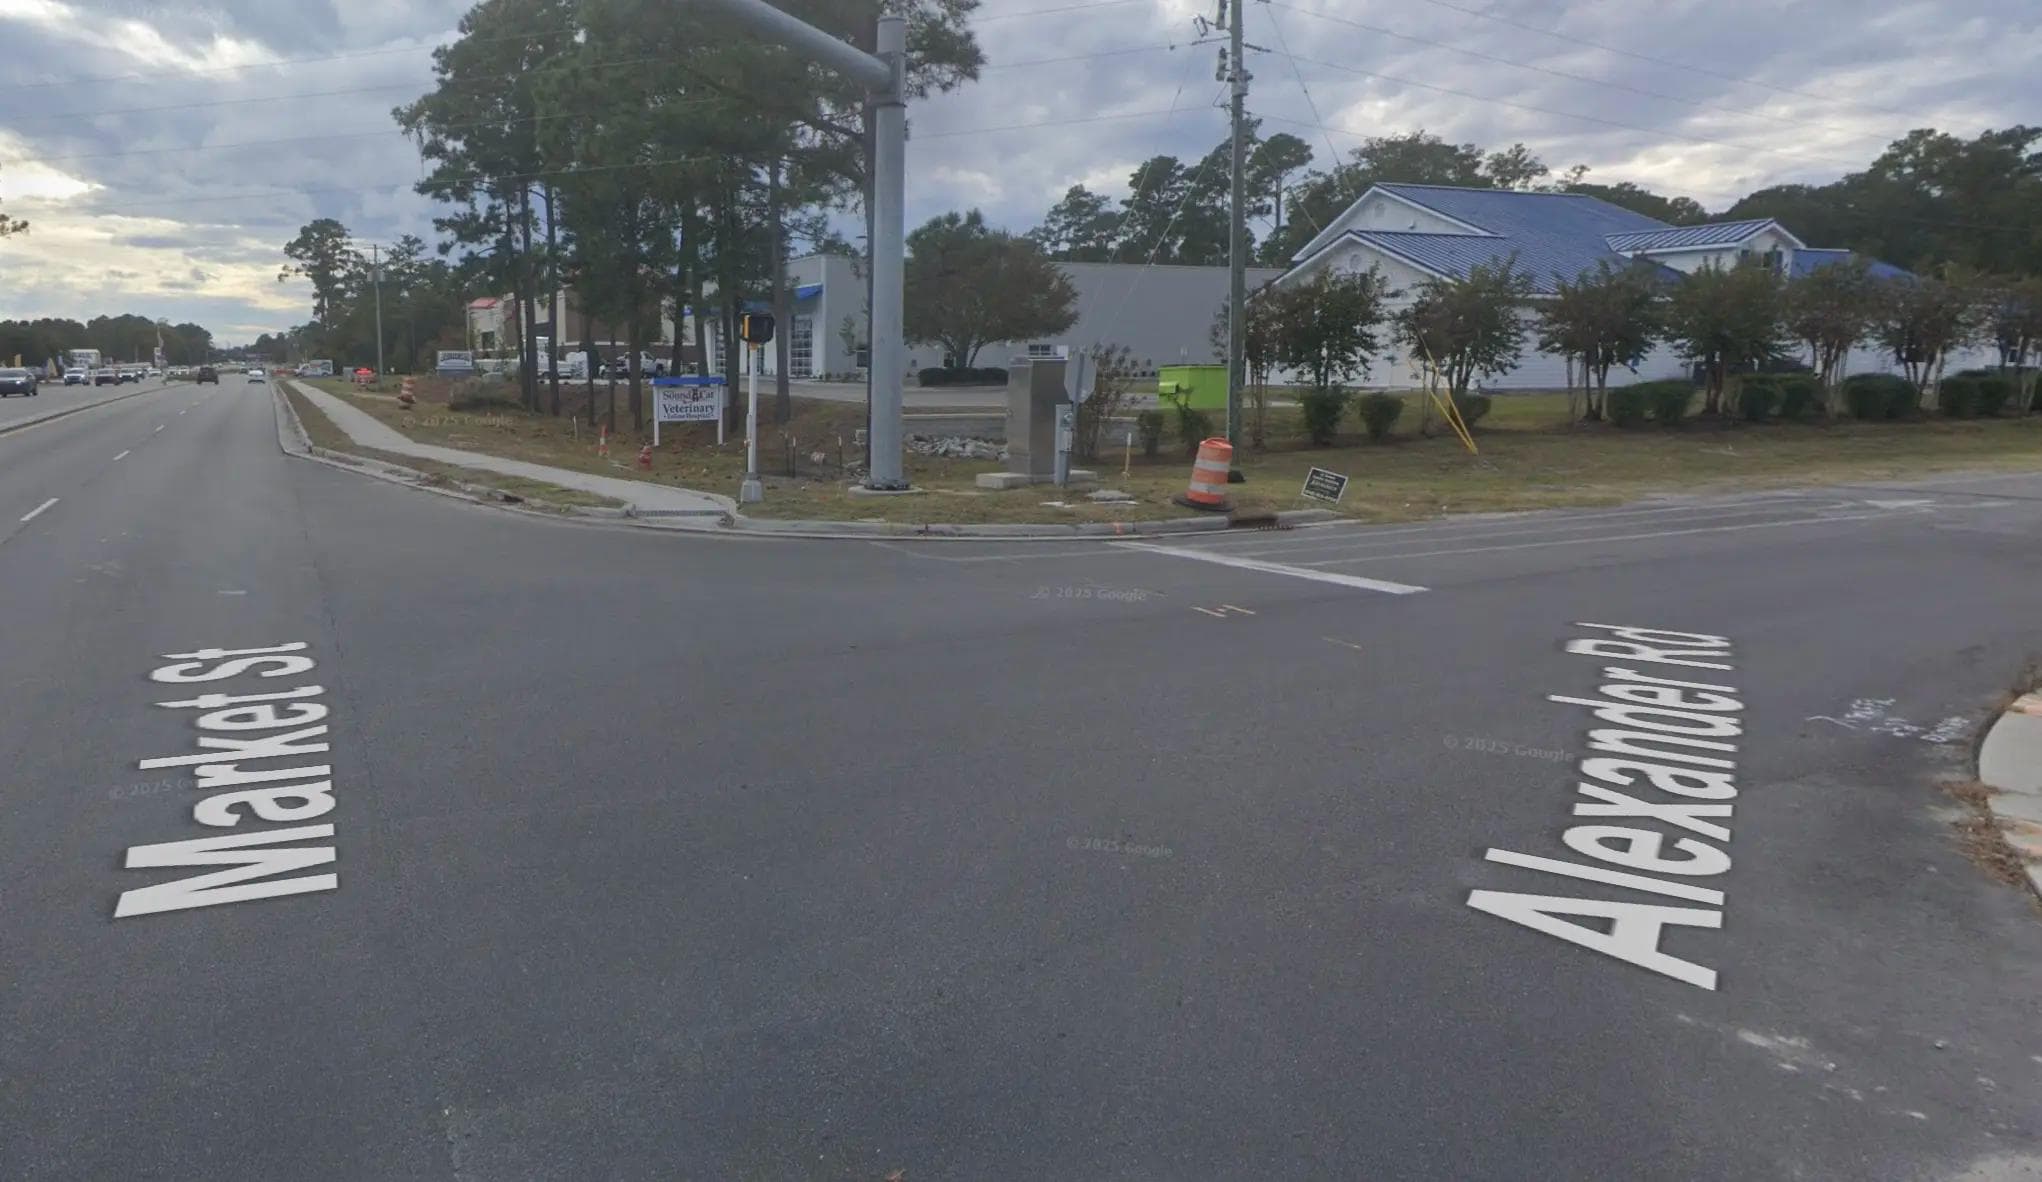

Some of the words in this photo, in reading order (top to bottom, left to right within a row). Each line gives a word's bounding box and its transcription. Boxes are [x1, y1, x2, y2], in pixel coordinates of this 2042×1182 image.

[662, 390, 691, 401] Sound
[699, 390, 714, 400] Cat
[662, 403, 715, 415] Veterinary
